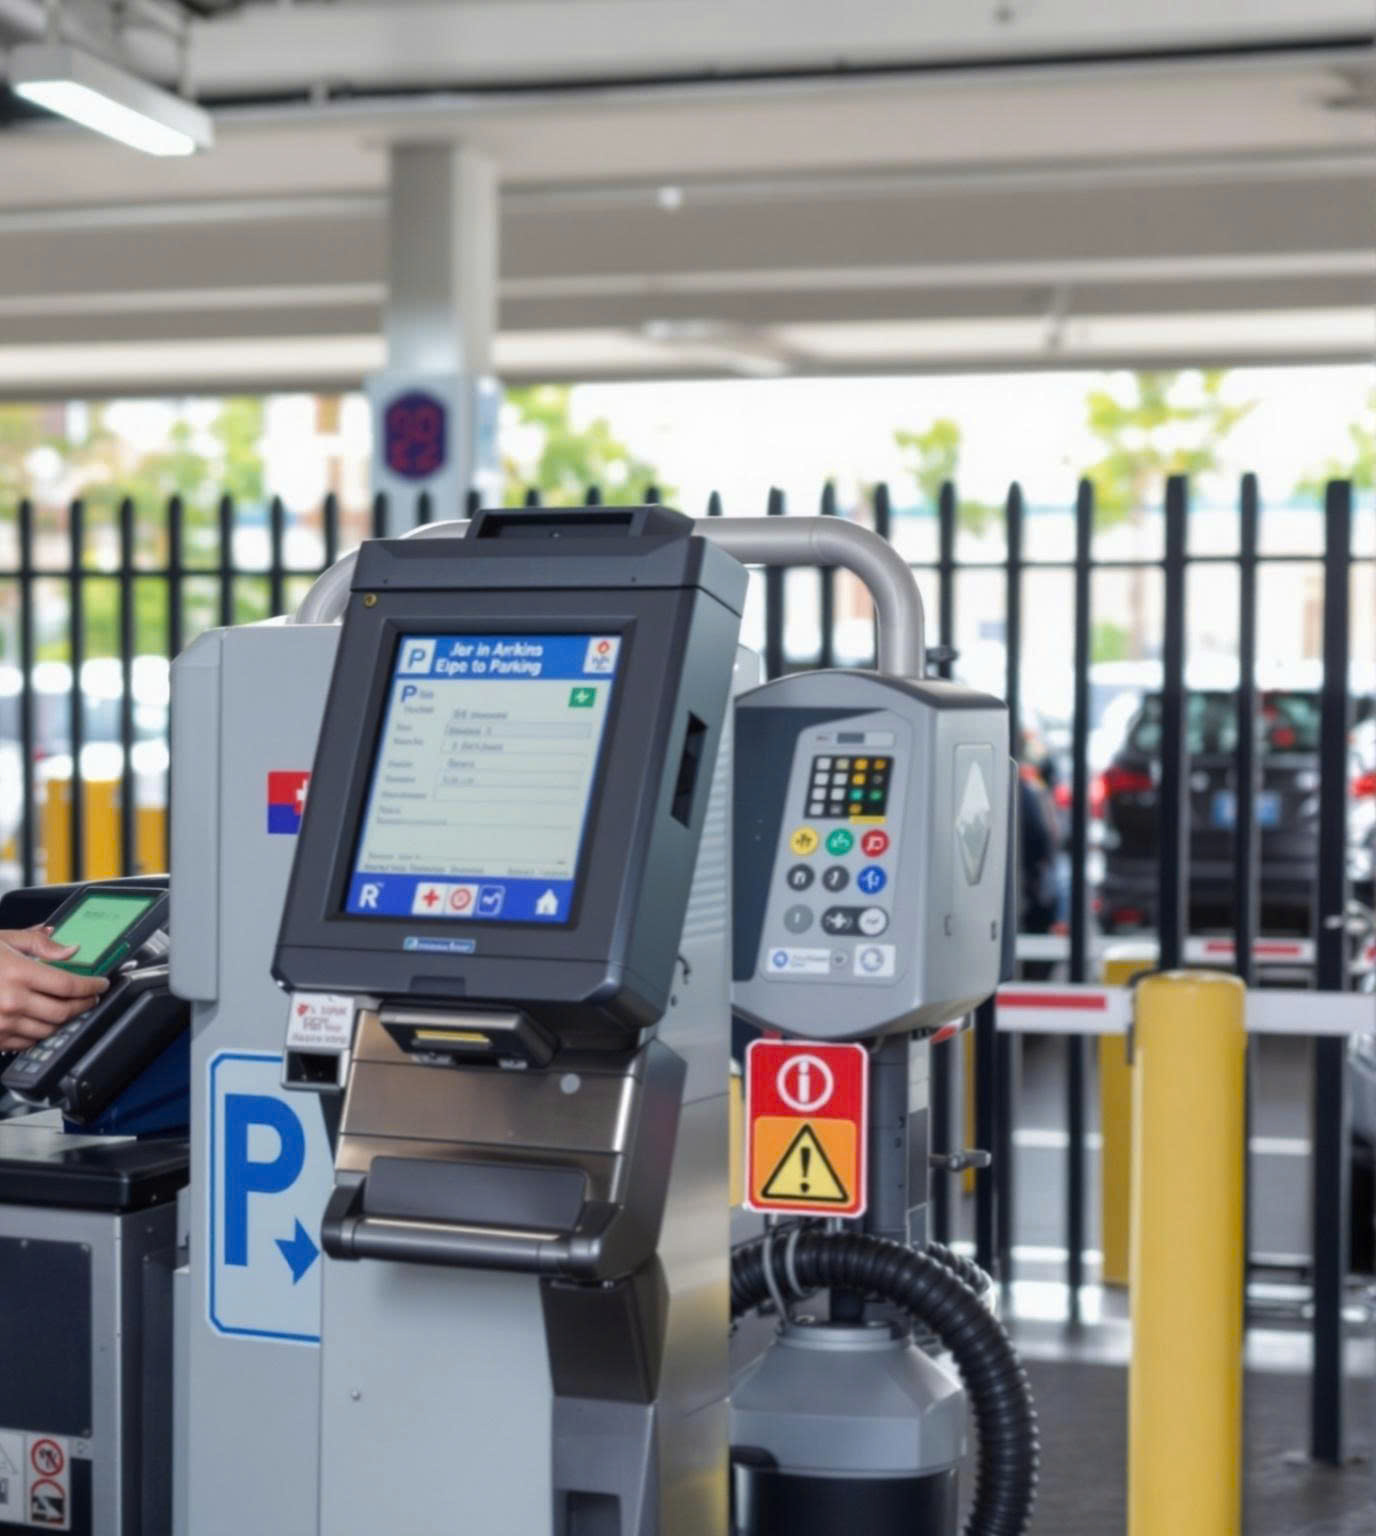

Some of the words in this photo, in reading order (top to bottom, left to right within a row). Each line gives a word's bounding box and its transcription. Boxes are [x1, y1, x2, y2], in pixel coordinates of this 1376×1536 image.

[409, 650, 426, 669] P
[472, 659, 487, 673] to
[489, 658, 543, 676] Parking
[401, 685, 418, 703] P
[358, 883, 379, 908] R
[224, 1093, 305, 1266] P
